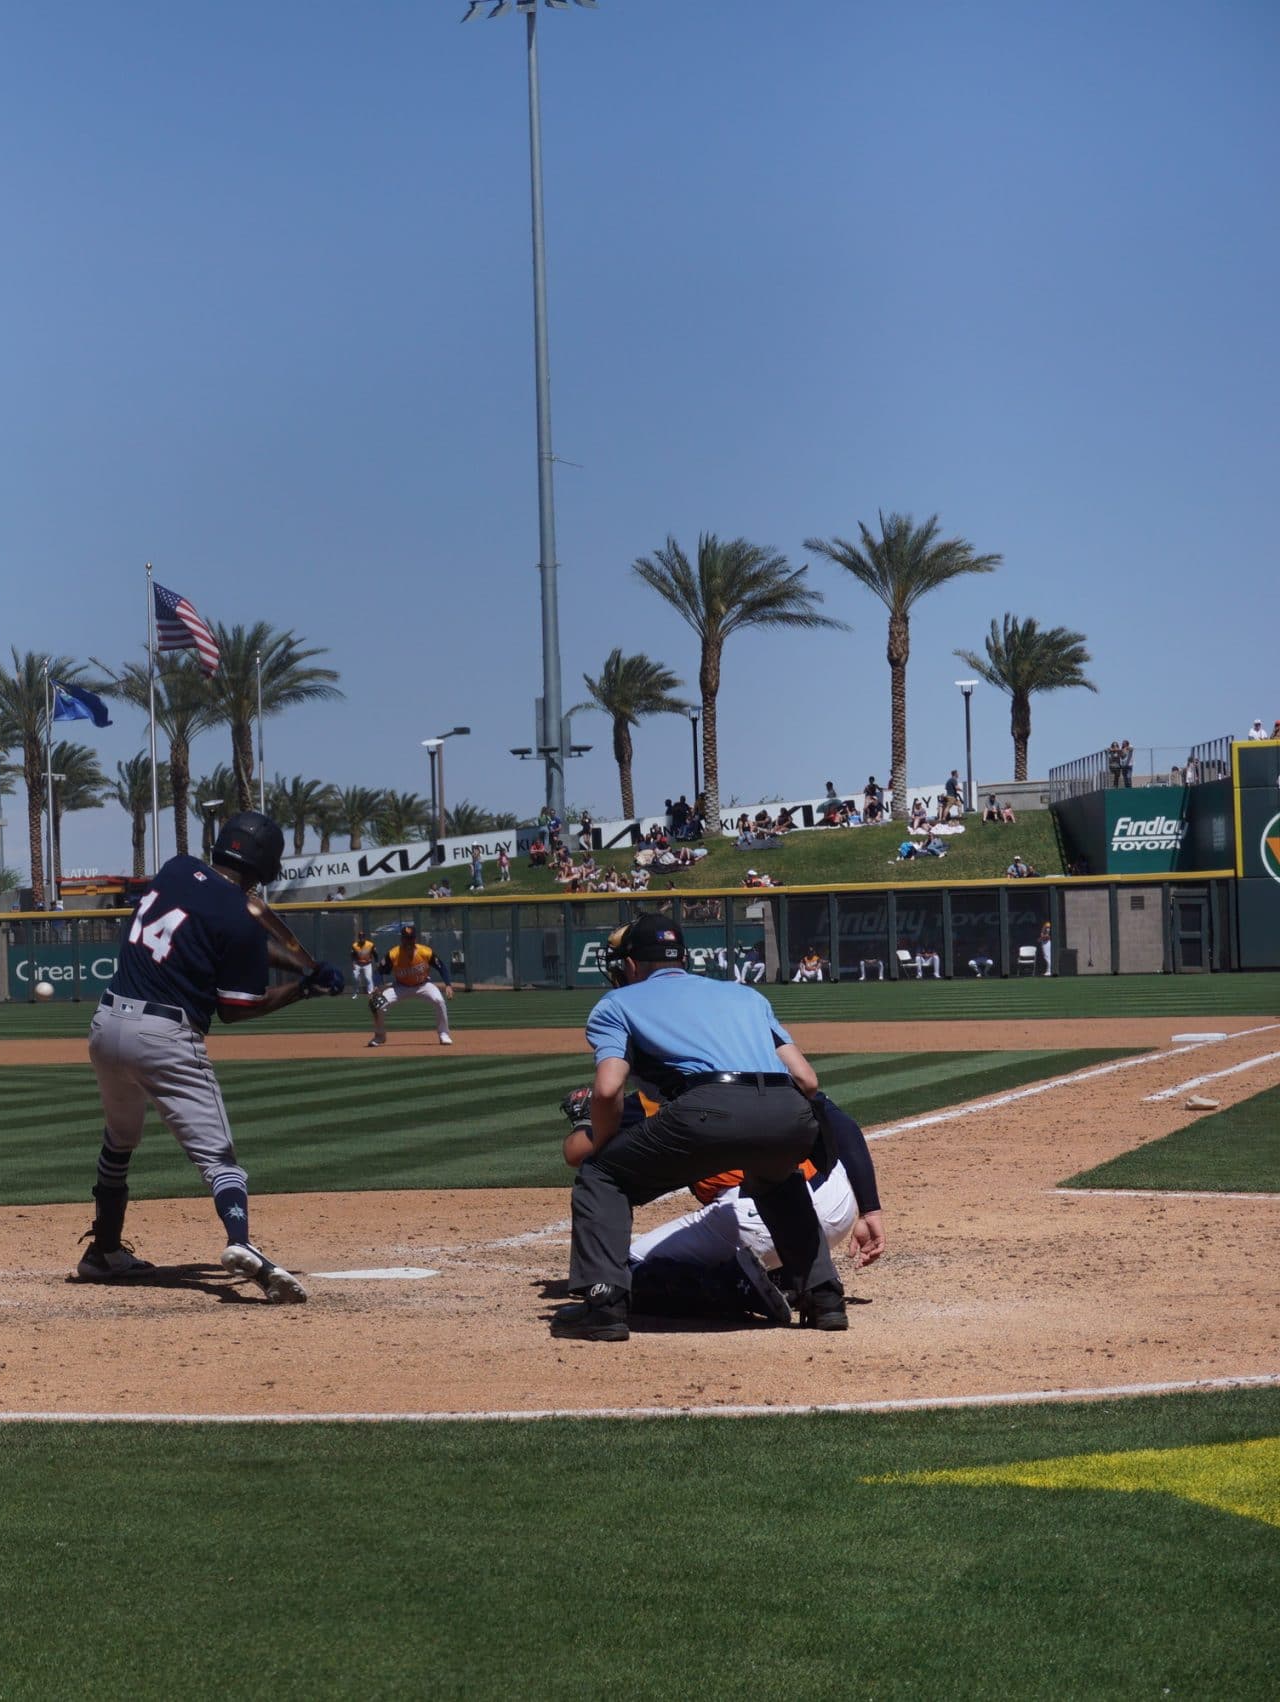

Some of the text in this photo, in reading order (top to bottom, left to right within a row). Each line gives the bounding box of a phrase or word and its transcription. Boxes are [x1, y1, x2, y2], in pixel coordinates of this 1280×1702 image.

[1111, 839, 1181, 851] TOYOTA
[275, 862, 350, 881] INDLAY KIA
[128, 890, 189, 964] 14
[15, 959, 89, 981] Great
